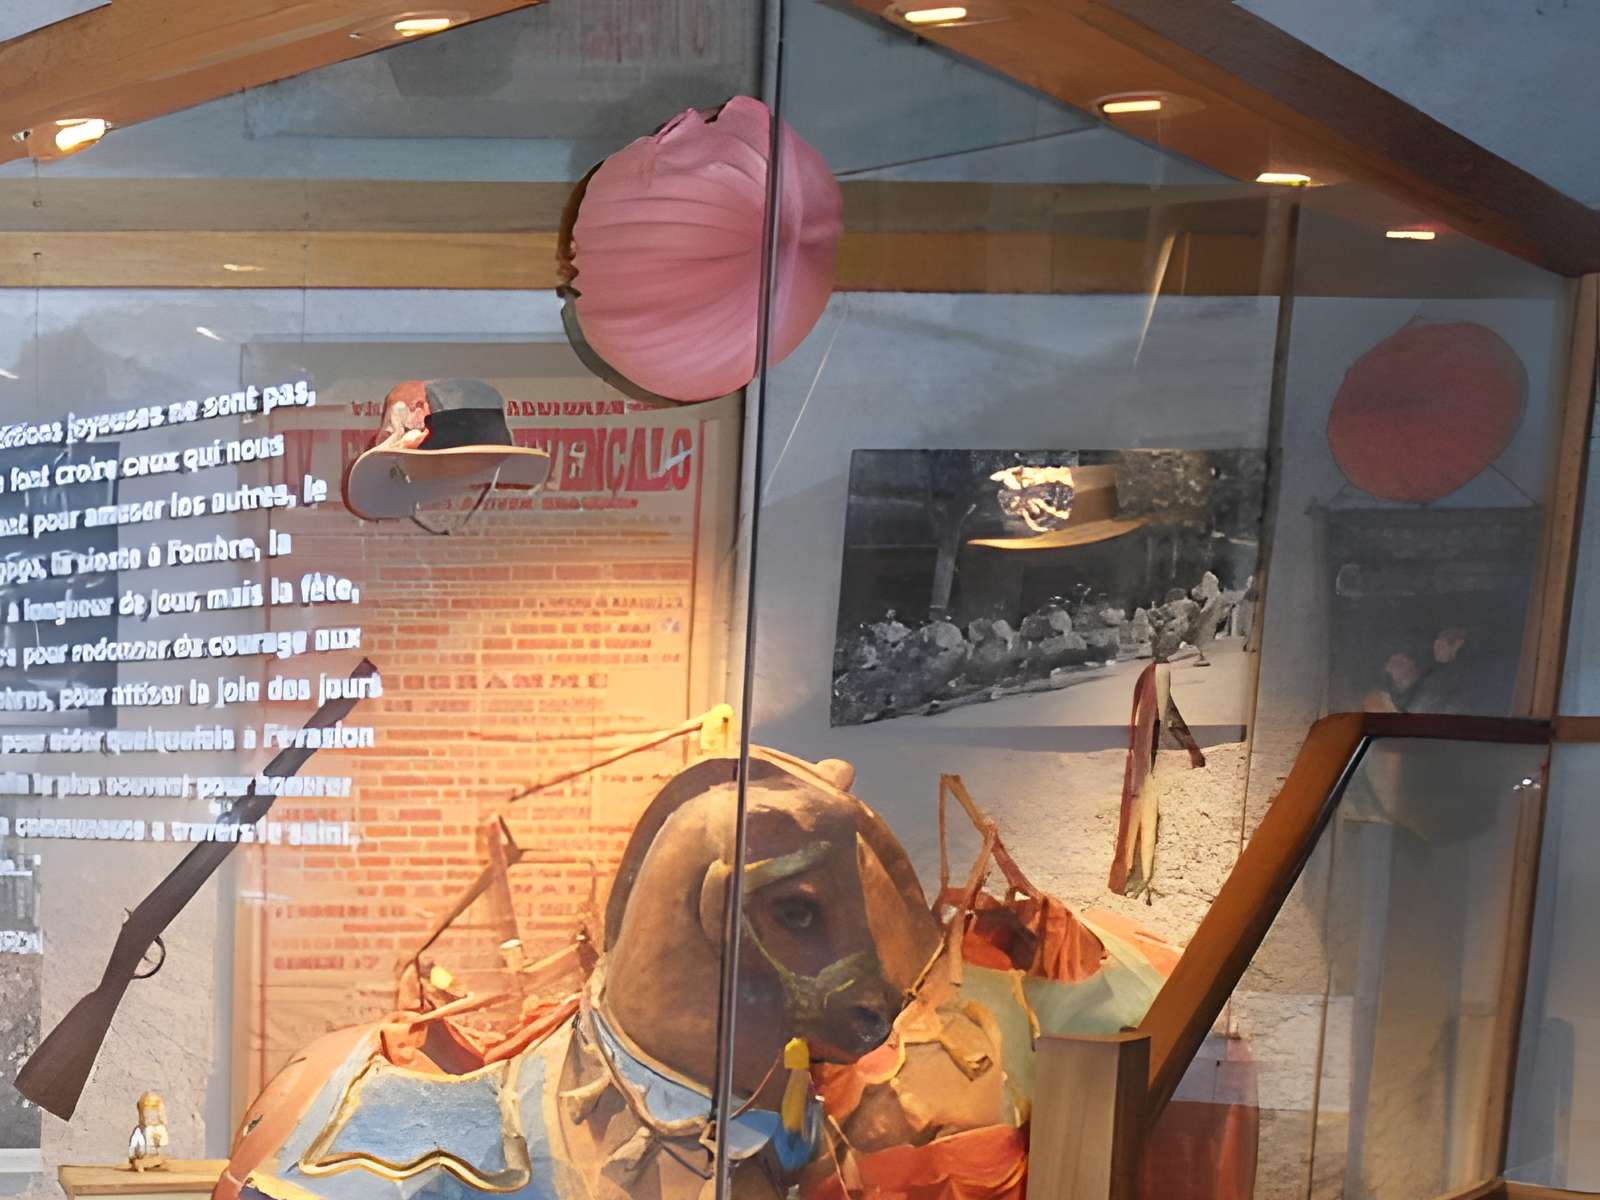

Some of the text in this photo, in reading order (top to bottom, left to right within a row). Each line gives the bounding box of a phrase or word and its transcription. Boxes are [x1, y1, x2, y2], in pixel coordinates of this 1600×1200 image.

[202, 385, 260, 419] sont
[263, 380, 317, 416] pas,
[183, 439, 222, 474] qui
[226, 434, 284, 465] nous
[33, 508, 82, 540] pour
[211, 484, 298, 514] autres,
[303, 474, 329, 503] le
[268, 529, 293, 557] la
[206, 579, 265, 610] mais
[270, 576, 295, 606] la
[300, 571, 362, 605] fête,
